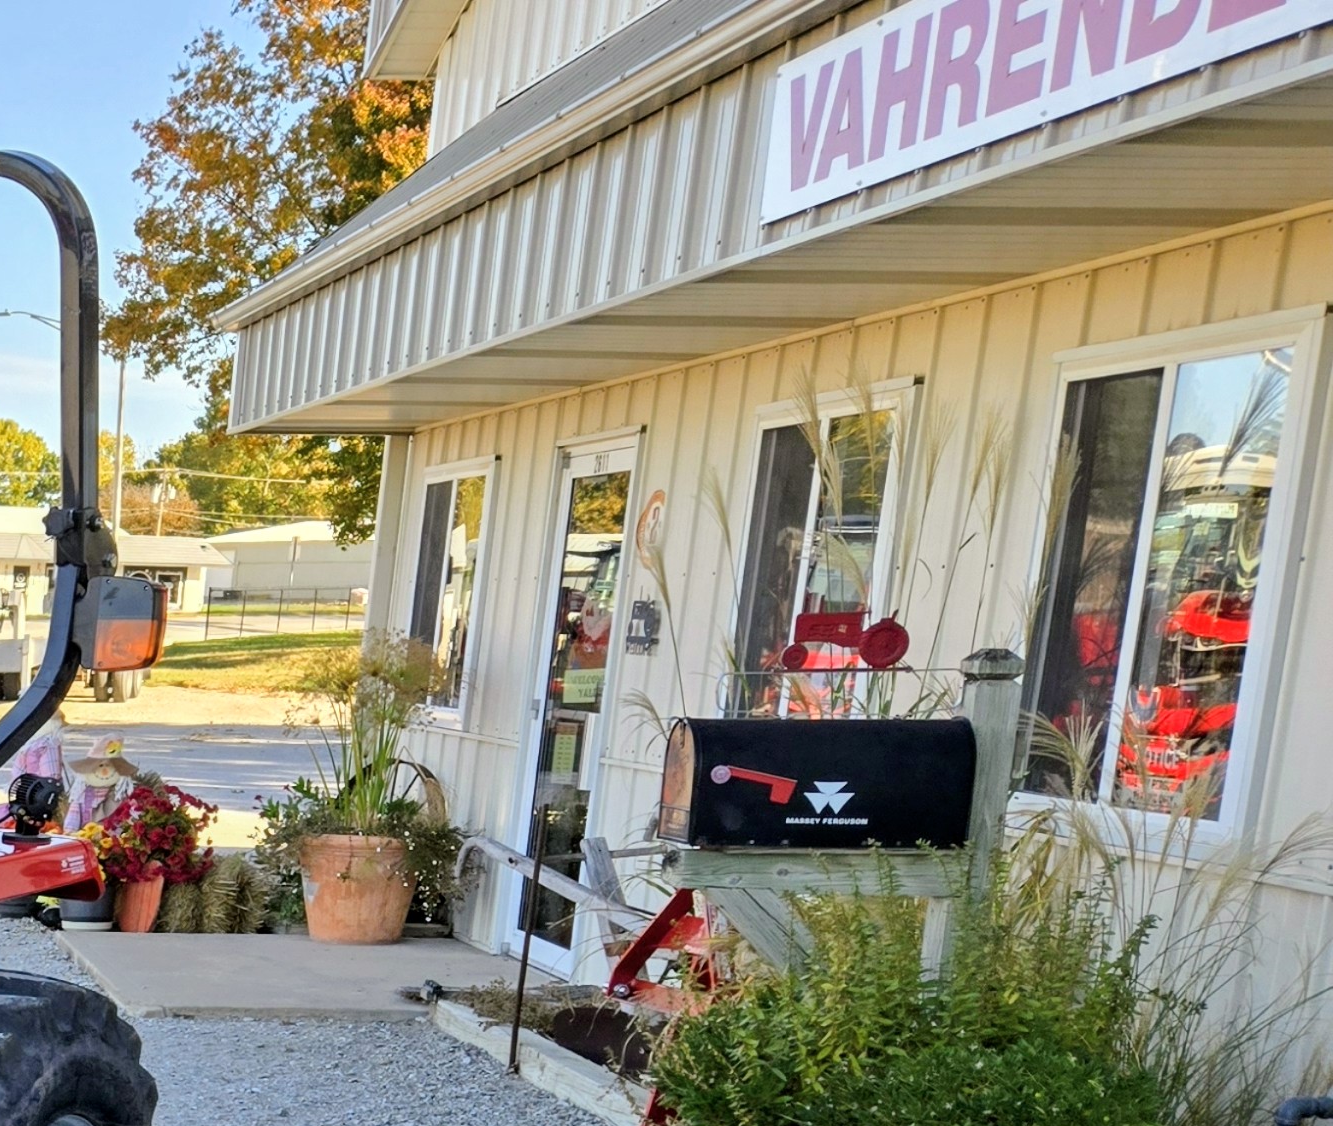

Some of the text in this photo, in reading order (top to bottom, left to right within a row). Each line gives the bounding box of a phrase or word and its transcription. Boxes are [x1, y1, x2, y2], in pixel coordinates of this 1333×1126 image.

[789, 0, 1287, 192] VAHREN
[785, 816, 869, 825] MASSEY FERGUSON
